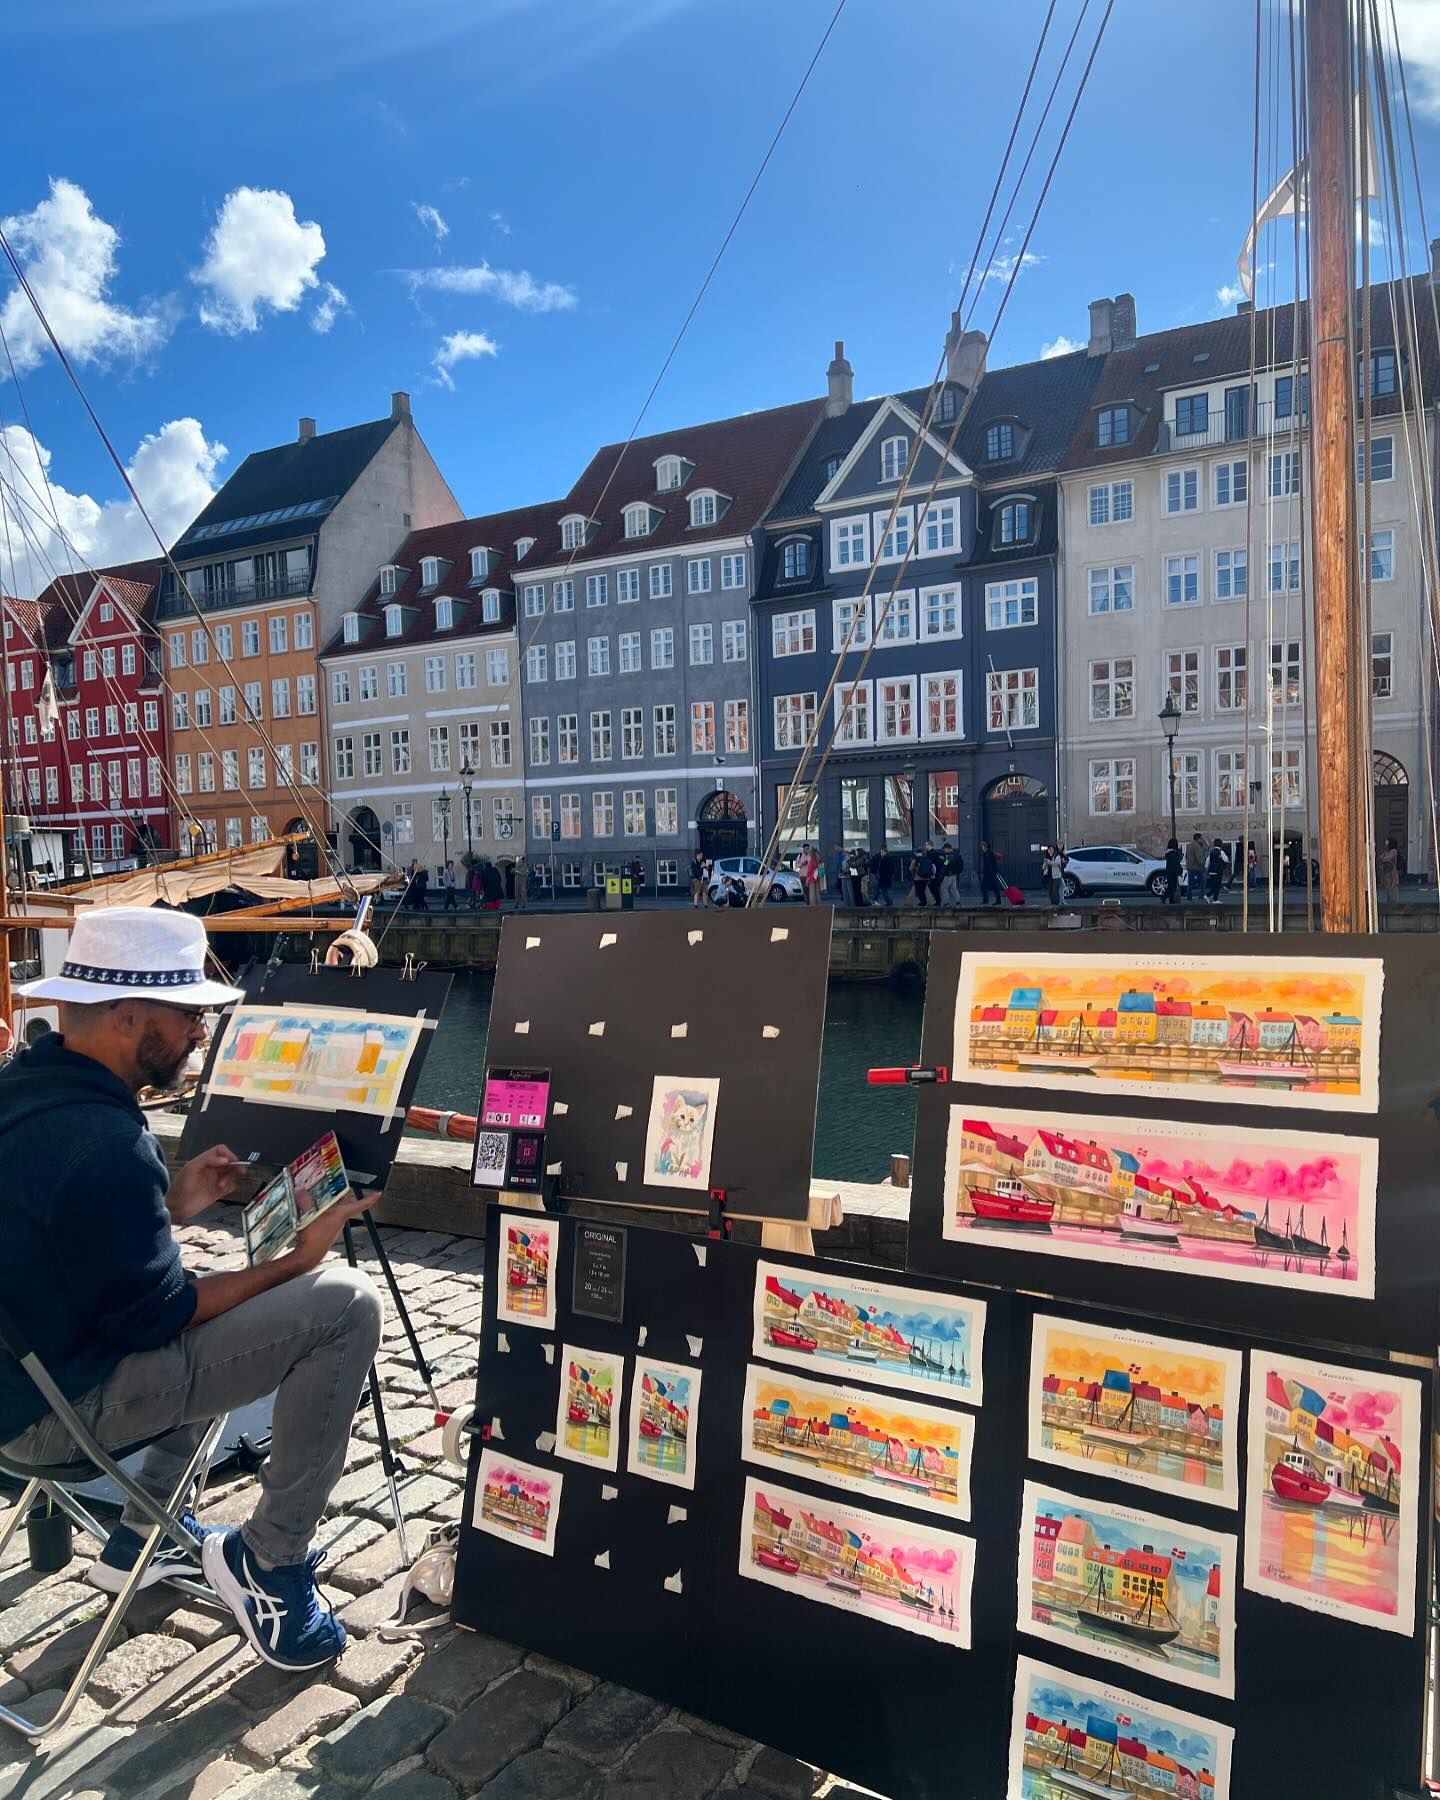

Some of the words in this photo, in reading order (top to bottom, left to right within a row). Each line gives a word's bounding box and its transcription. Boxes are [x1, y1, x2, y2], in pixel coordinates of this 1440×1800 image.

[553, 823, 559, 833] P
[584, 1230, 617, 1244] ORIGINAL
[584, 1282, 592, 1290] 20
